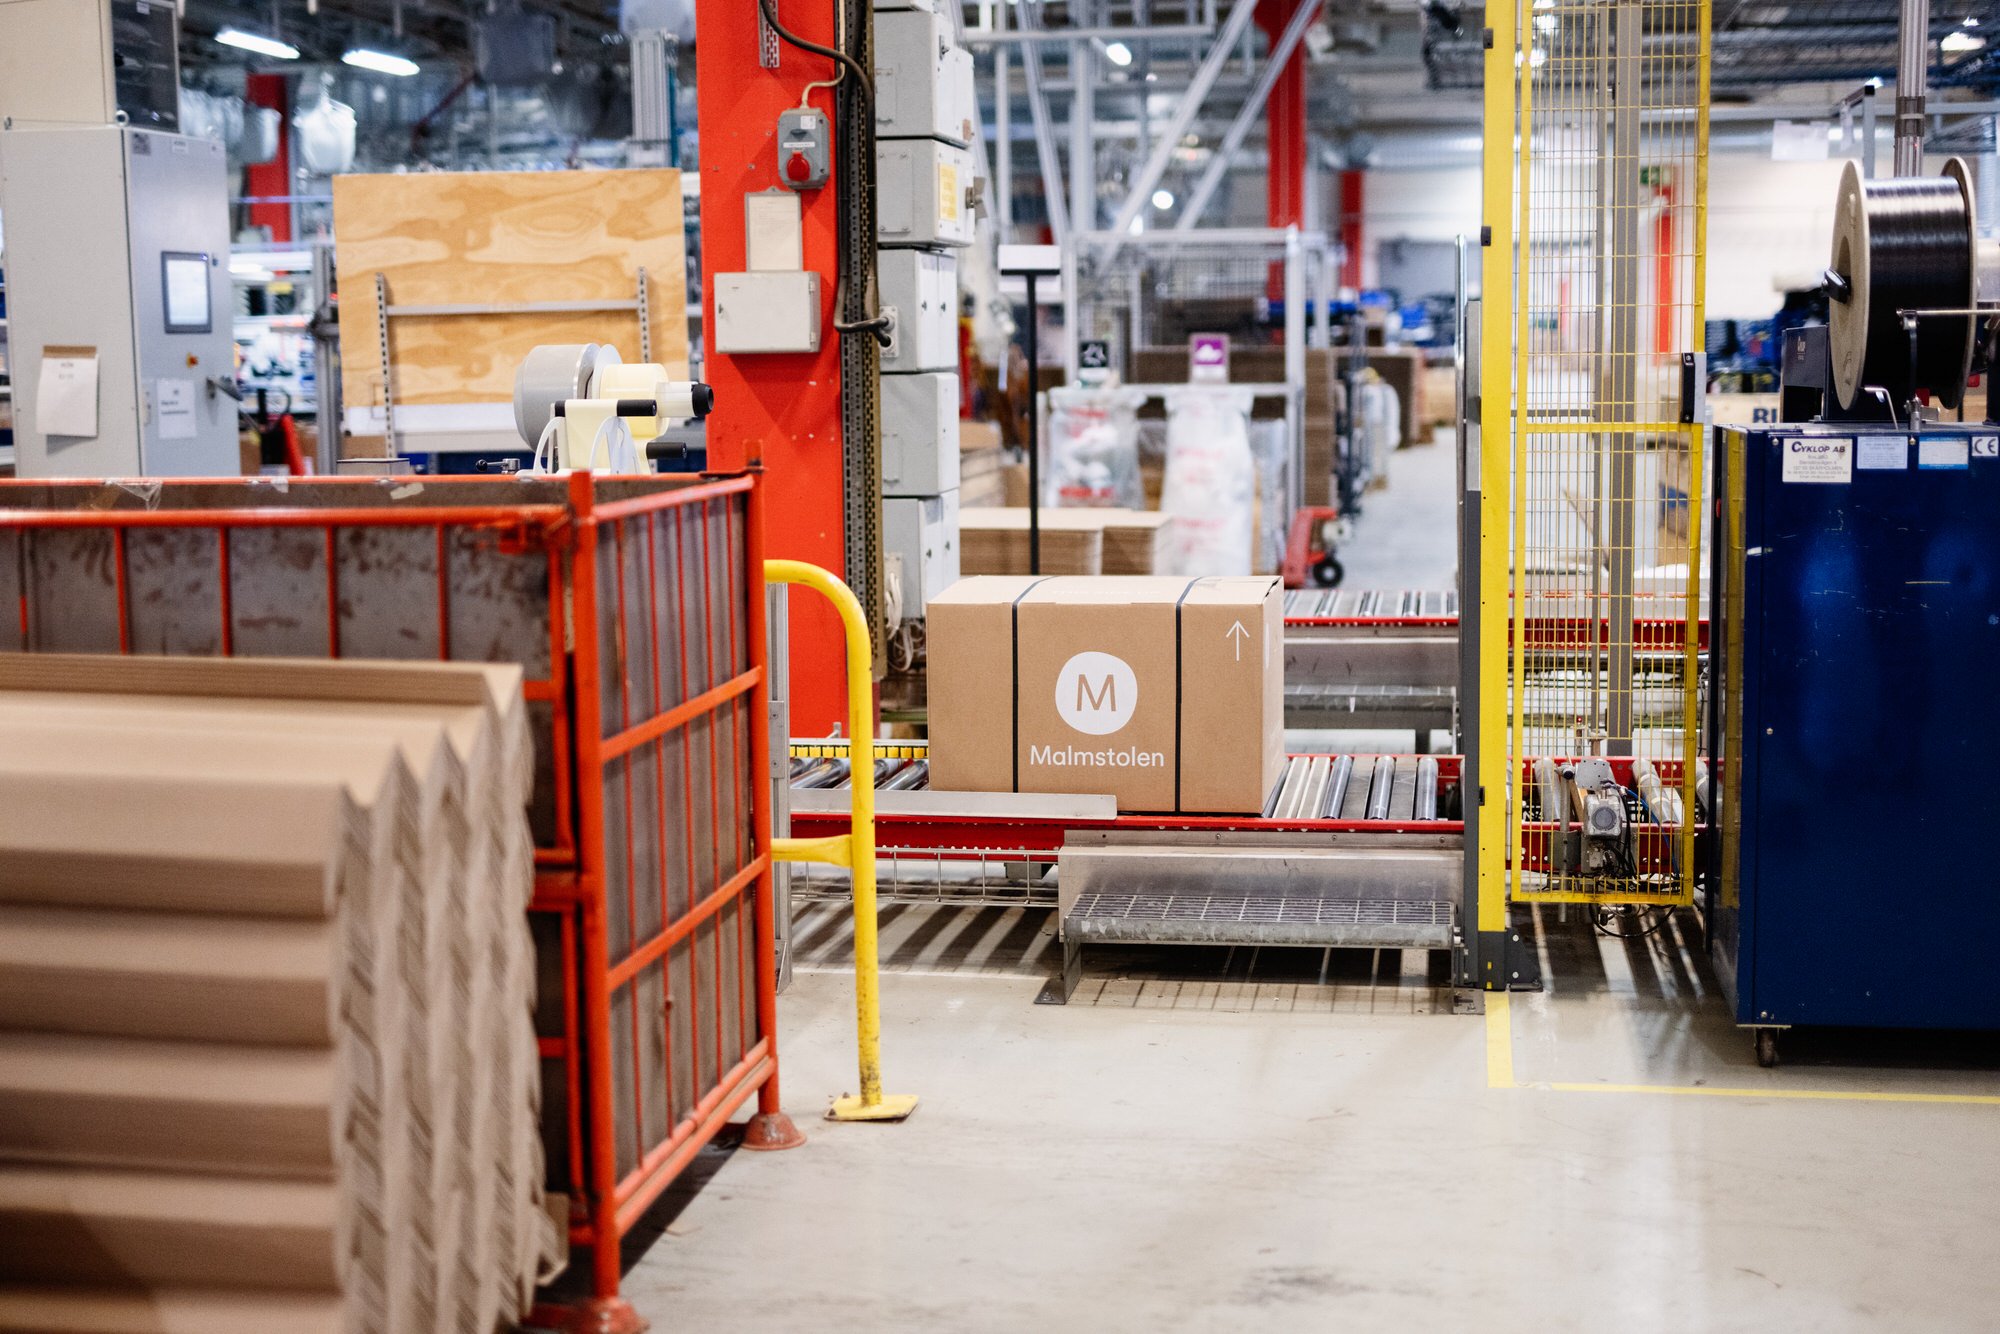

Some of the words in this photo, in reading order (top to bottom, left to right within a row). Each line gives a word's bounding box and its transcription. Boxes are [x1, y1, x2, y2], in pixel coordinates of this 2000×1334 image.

[1974, 438, 1996, 454] CE
[1076, 673, 1117, 712] M
[1030, 745, 1164, 767] Malmstolen
